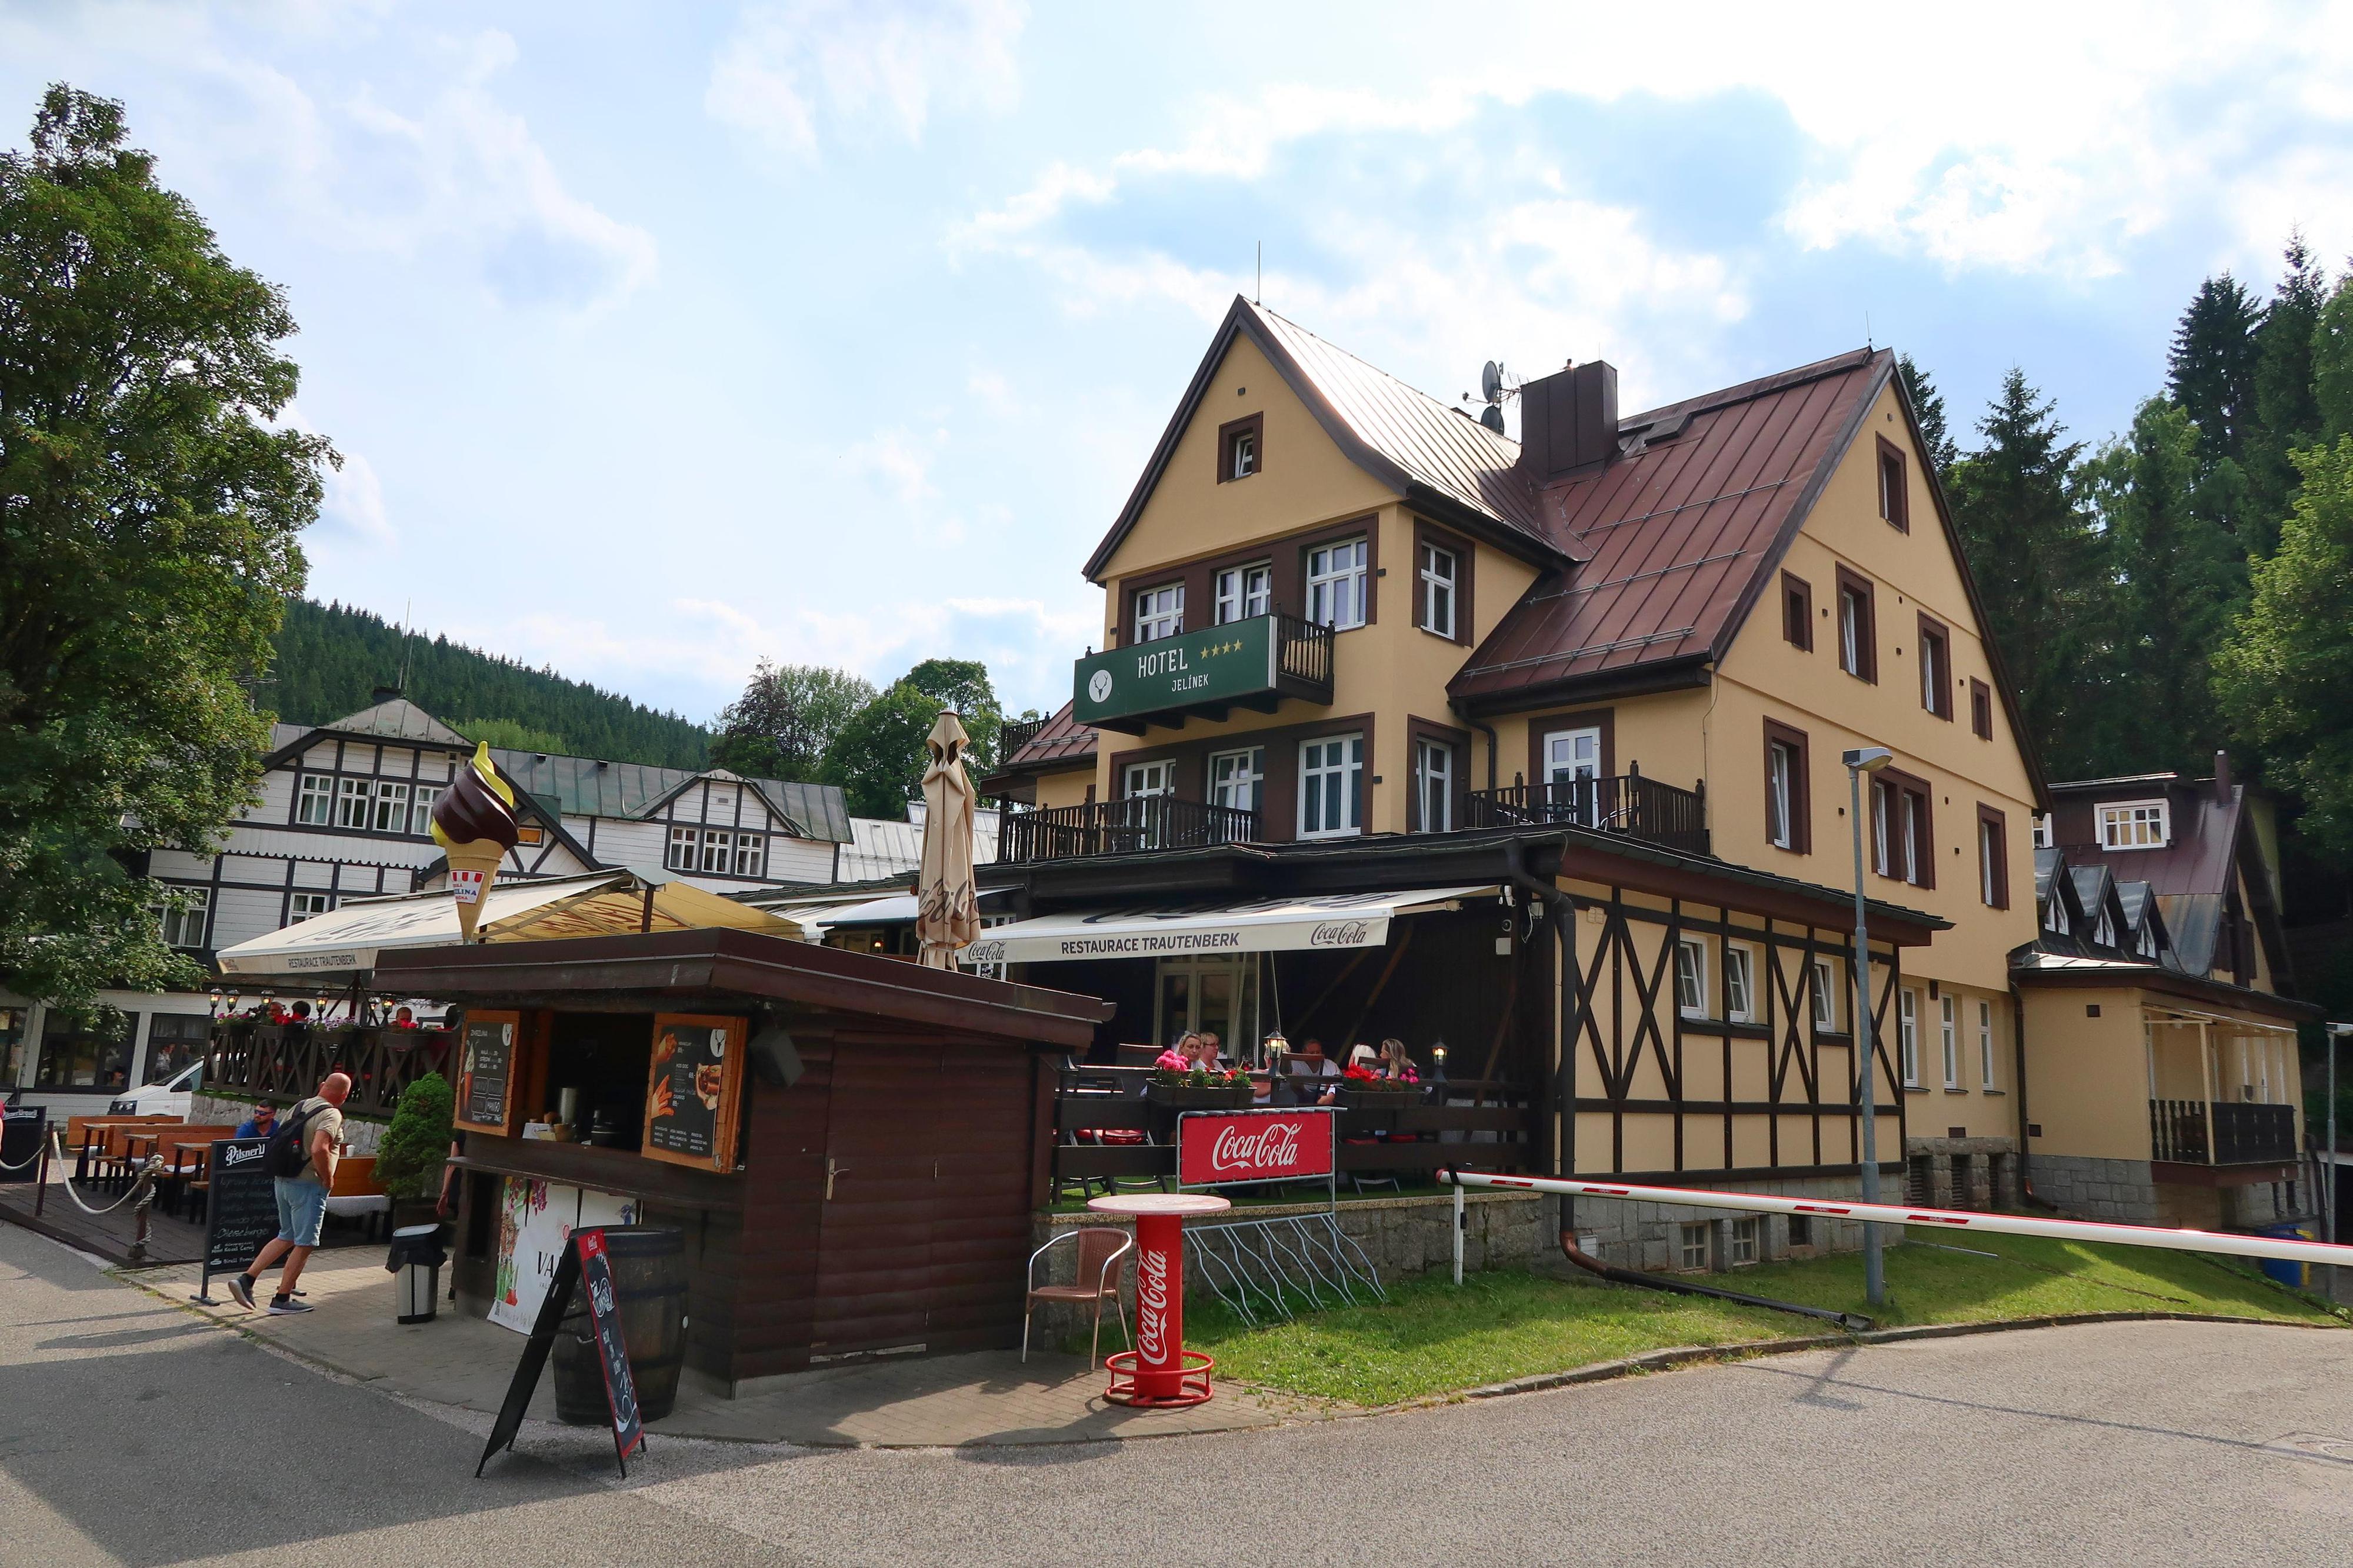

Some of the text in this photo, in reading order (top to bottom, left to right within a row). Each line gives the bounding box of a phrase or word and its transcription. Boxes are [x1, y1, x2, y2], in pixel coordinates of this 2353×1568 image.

[1138, 648, 1188, 678] HOTEL
[1171, 673, 1209, 692] JELÍNEK
[1061, 932, 1240, 955] RESTAURACE TRAUTENBERK
[1311, 920, 1369, 945] Coca-Cola
[288, 954, 357, 968] RESTAURACE TRAUTENBERK
[968, 941, 1006, 961] Coca-Cola
[1212, 1123, 1303, 1170] Coca-Cola
[1137, 1242, 1167, 1365] Coca-Cola
